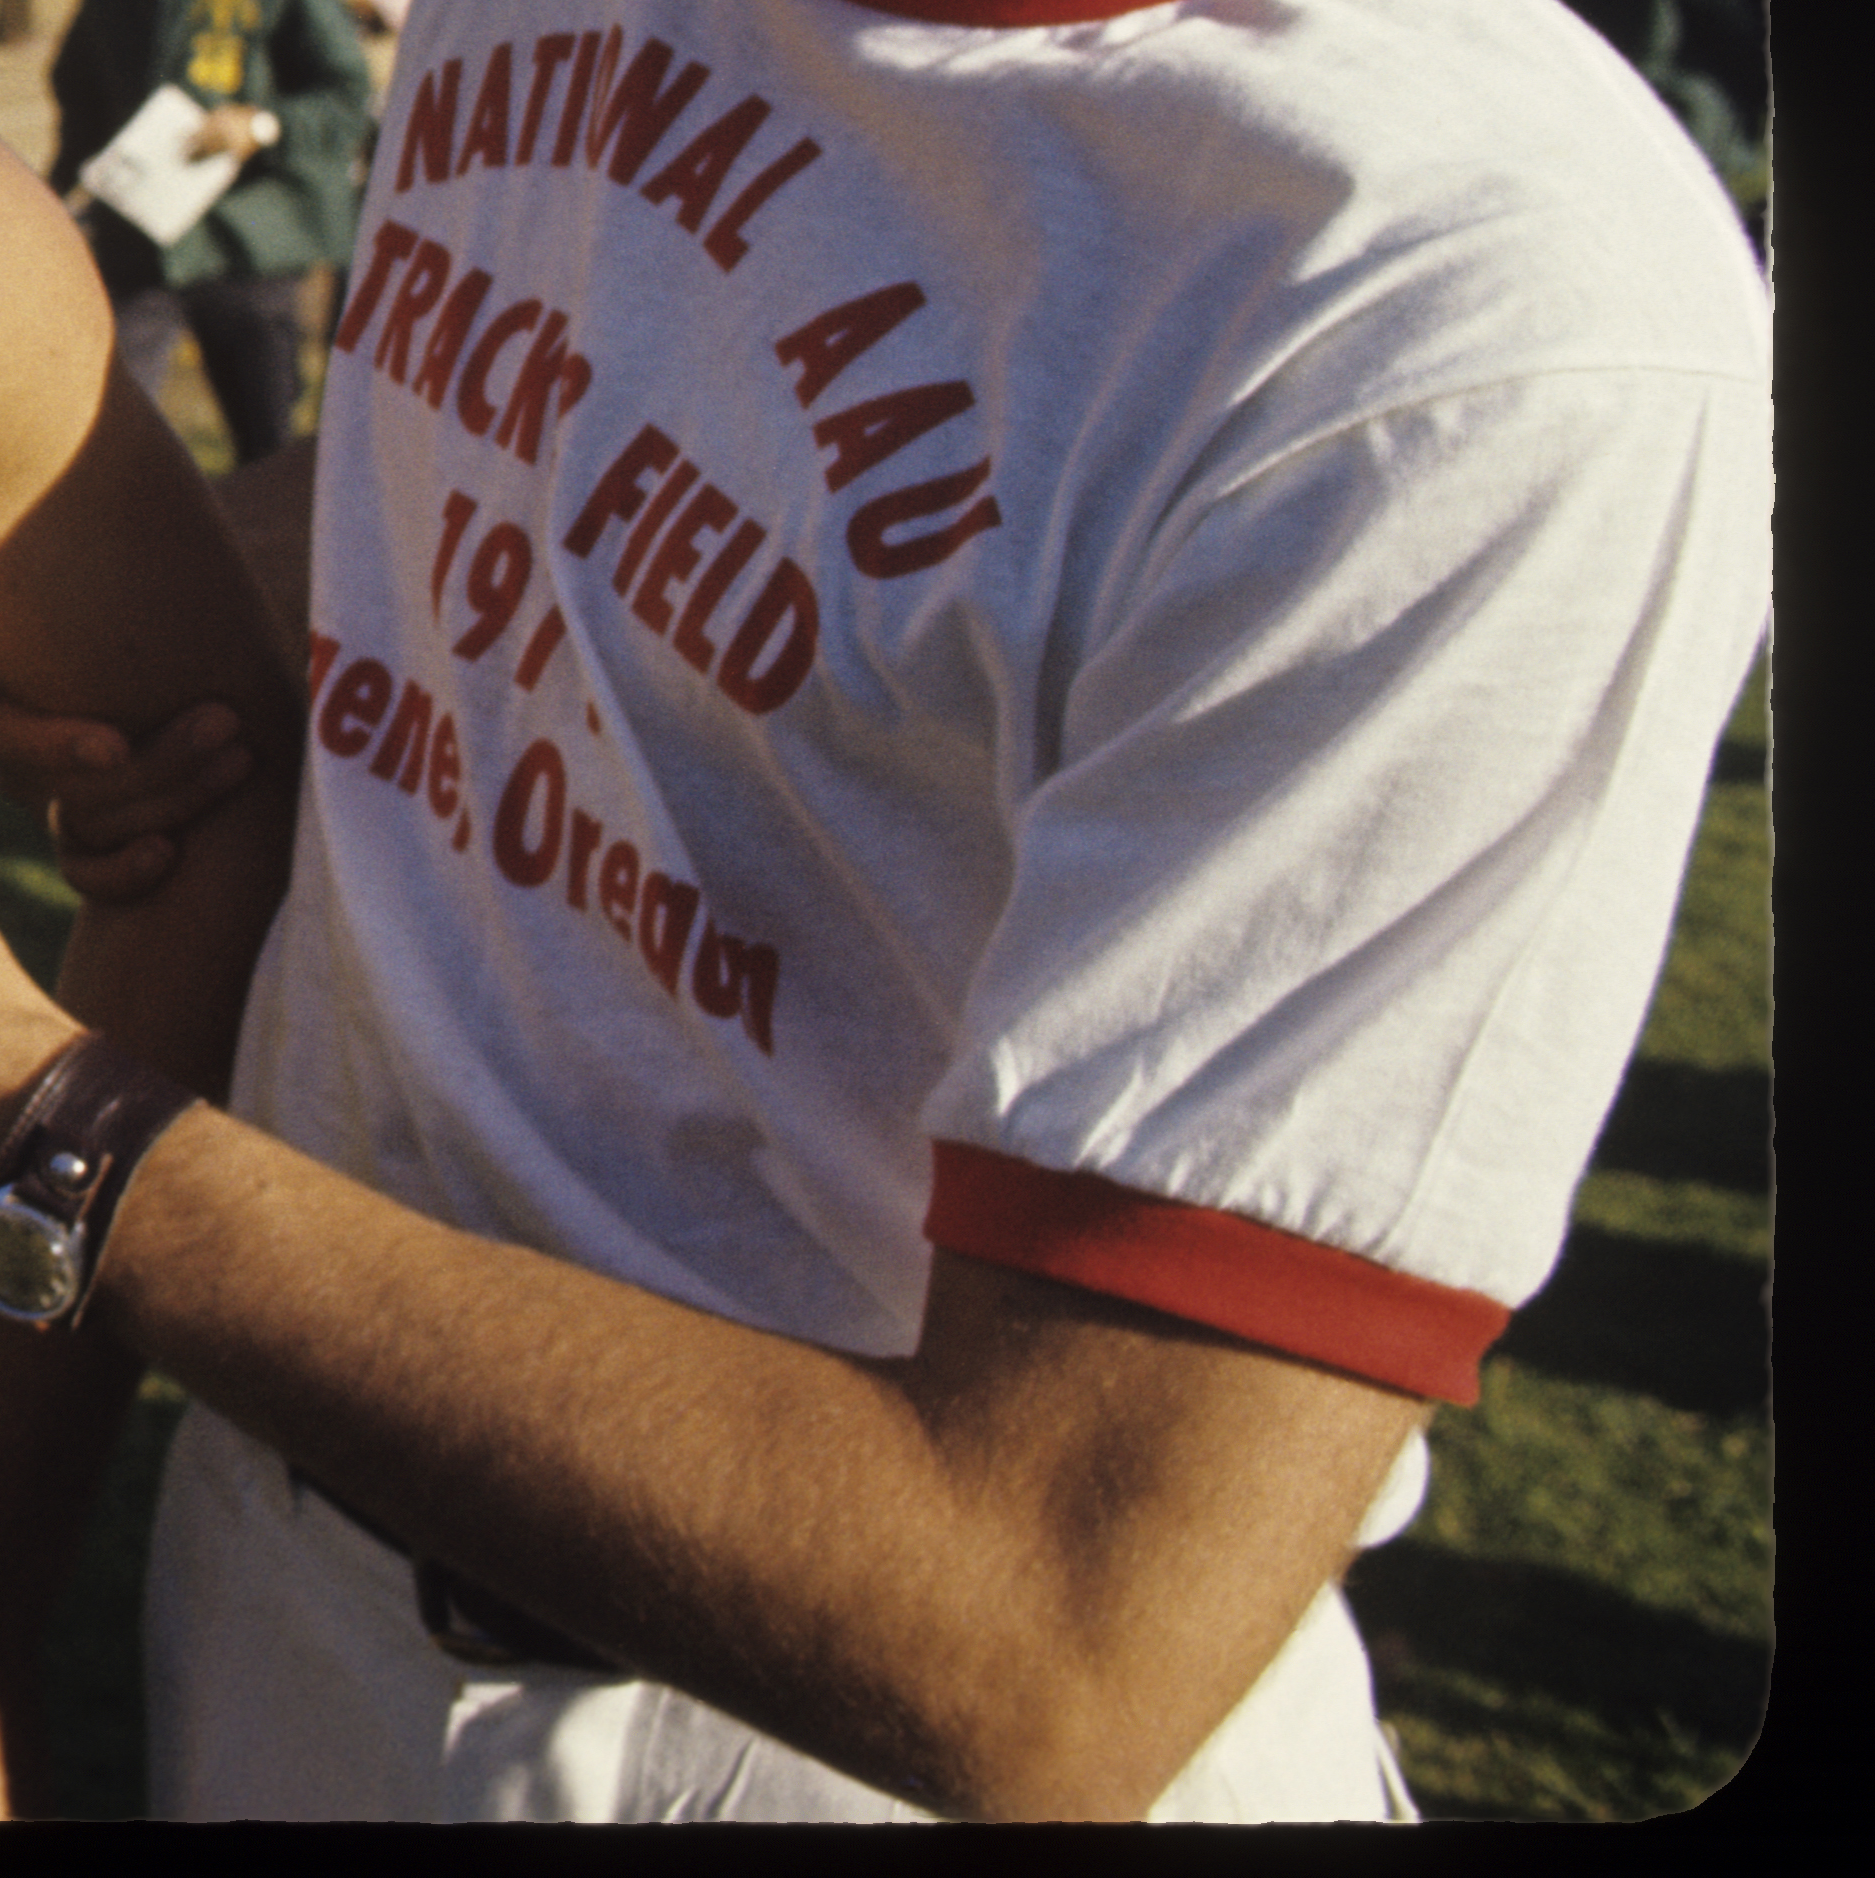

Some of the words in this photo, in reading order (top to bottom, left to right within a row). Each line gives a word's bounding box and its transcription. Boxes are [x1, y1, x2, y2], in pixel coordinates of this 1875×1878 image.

[334, 219, 572, 467] TRACK
[562, 422, 820, 715] FIELD
[773, 281, 1003, 581] AAU
